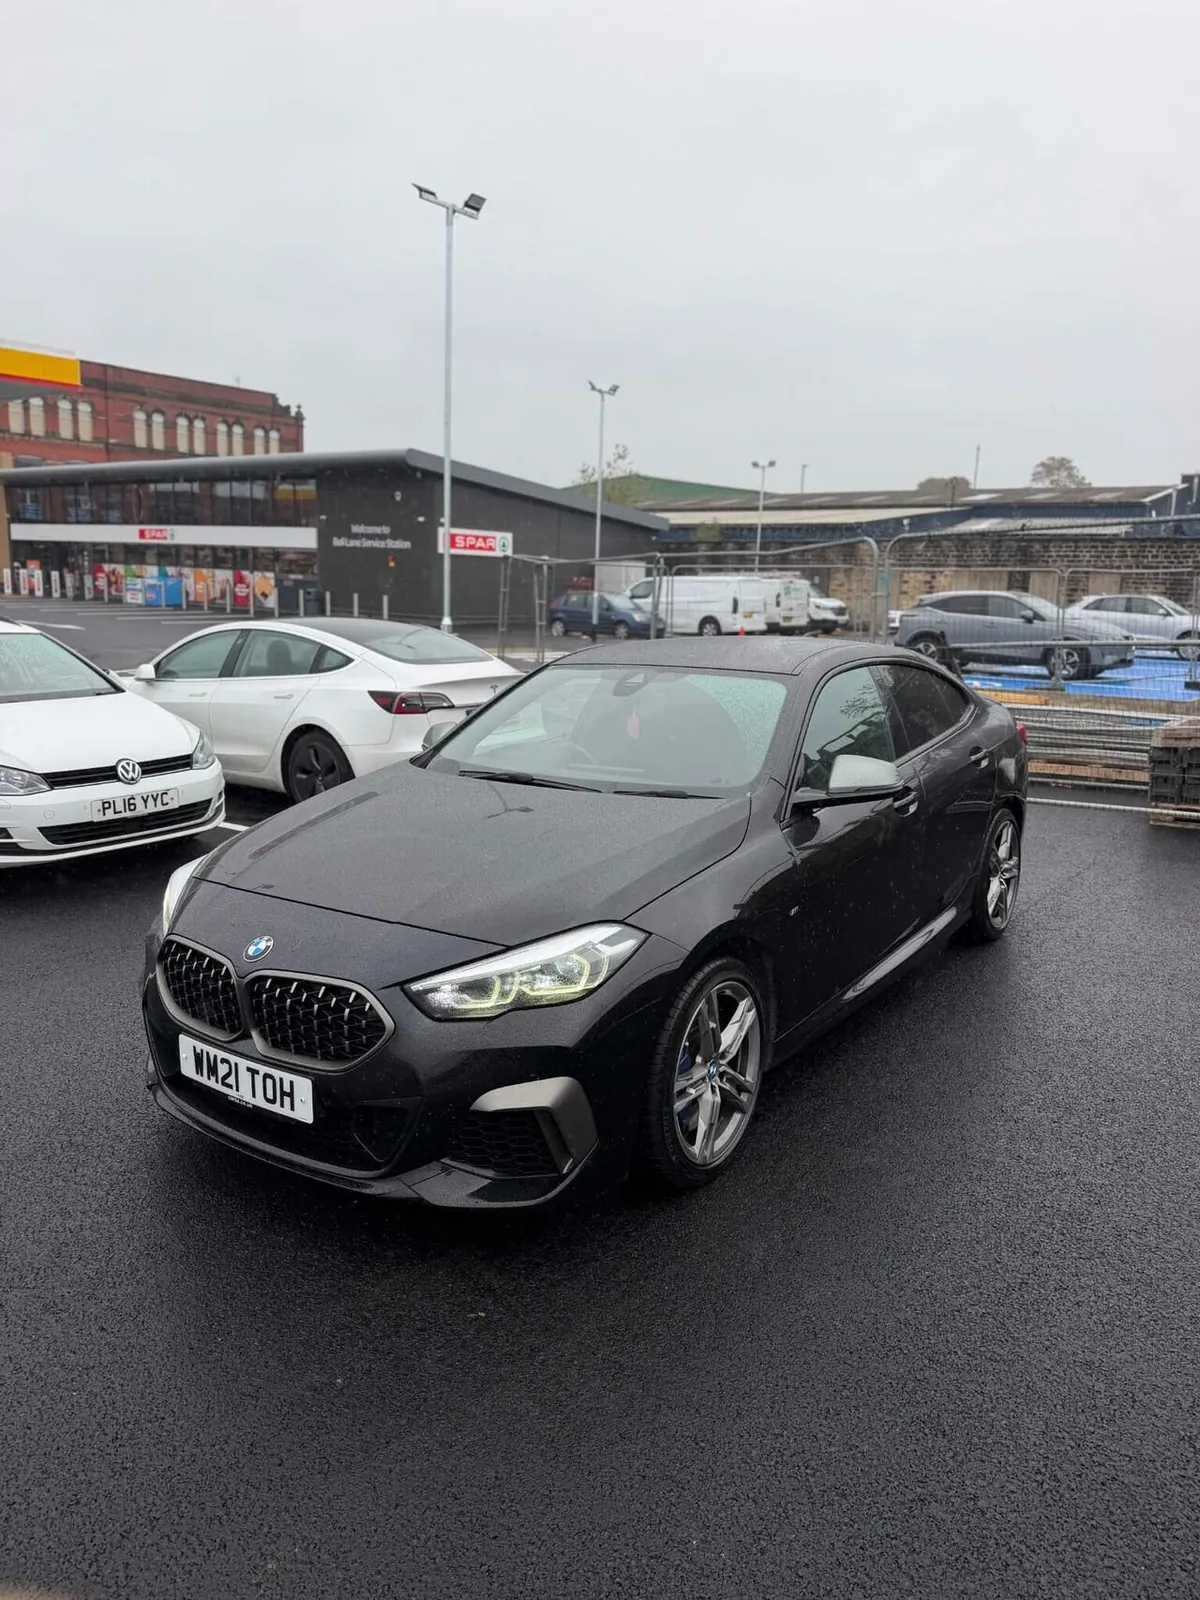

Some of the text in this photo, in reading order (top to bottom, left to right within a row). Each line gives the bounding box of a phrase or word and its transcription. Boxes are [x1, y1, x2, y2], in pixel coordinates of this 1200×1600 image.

[454, 535, 496, 549] SPAR
[102, 792, 169, 816] PL16 YYC
[193, 1045, 295, 1112] WM21 TOH
